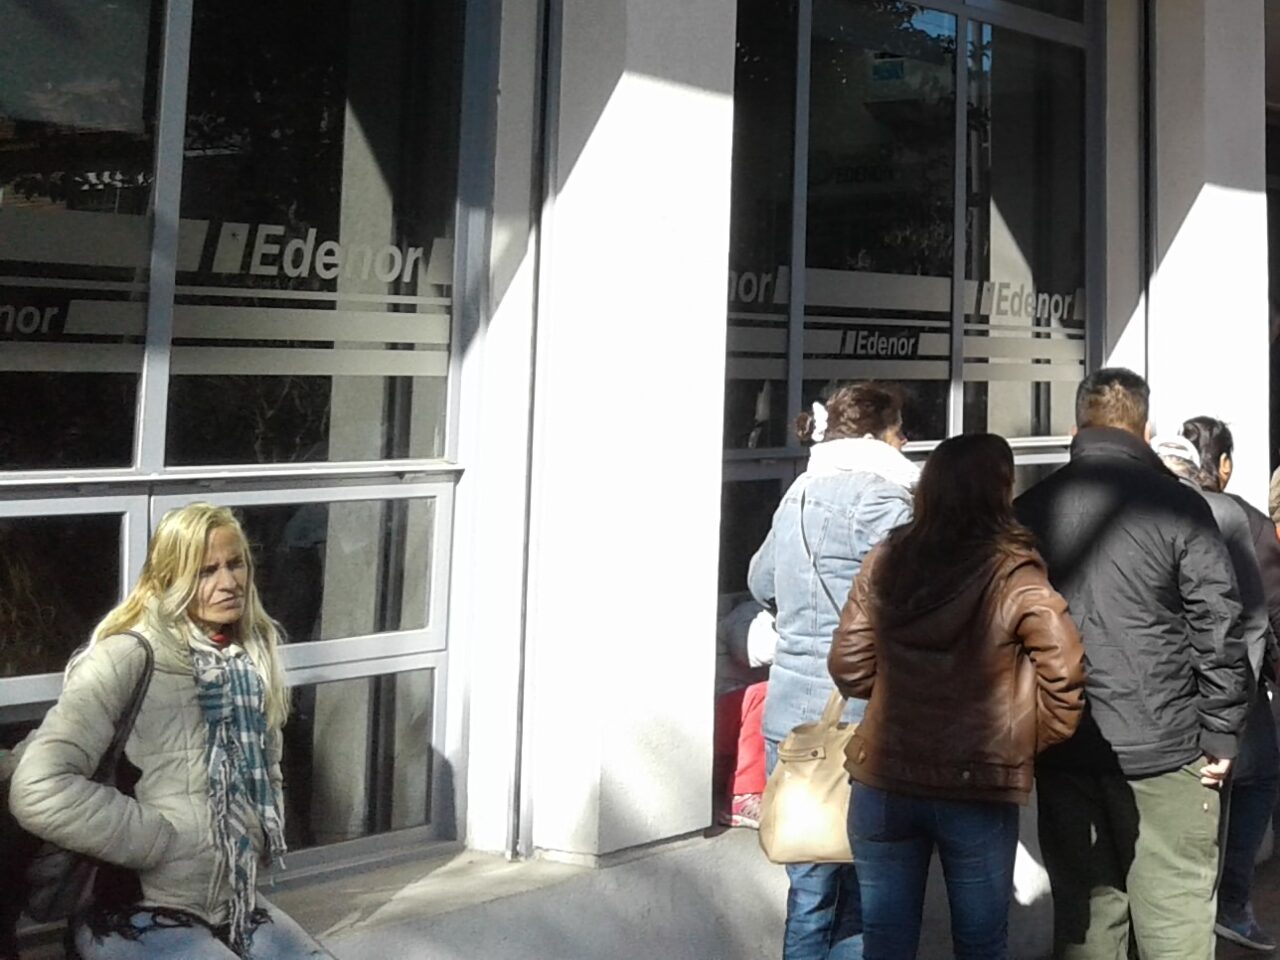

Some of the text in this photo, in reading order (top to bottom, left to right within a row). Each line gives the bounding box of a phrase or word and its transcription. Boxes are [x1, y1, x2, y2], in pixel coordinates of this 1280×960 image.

[249, 224, 424, 283] Edenor
[995, 282, 1073, 319] Edenor
[856, 330, 916, 356] Edenor
